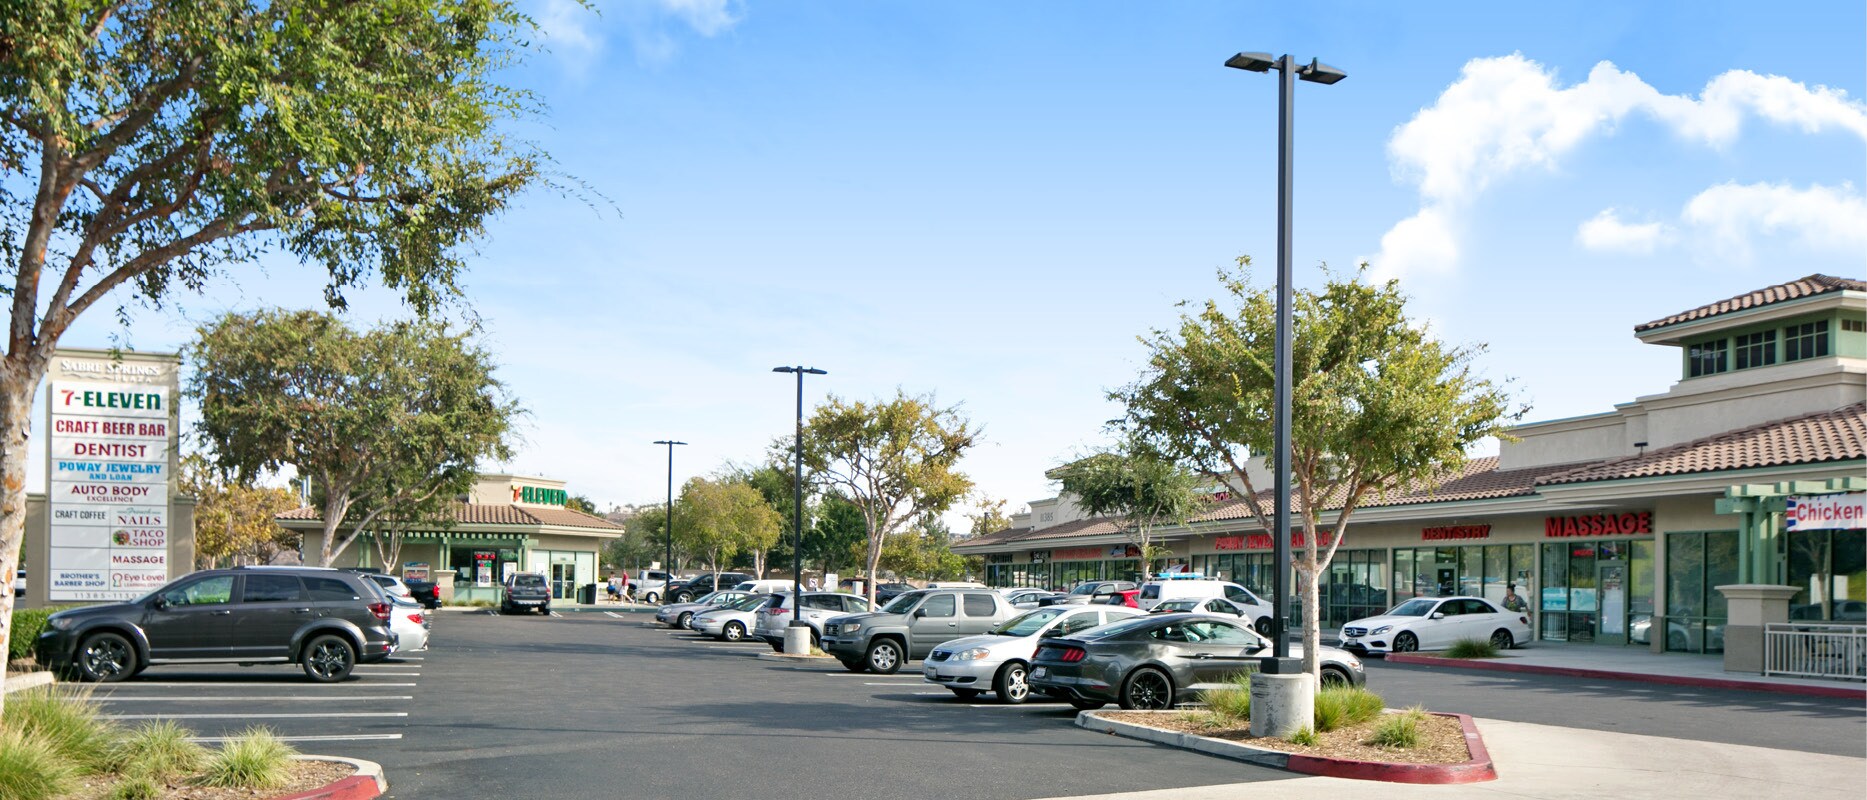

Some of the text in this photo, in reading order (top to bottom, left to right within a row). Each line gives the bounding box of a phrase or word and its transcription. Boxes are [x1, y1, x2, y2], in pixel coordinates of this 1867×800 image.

[56, 420, 165, 437] CRAFT BEER BAR
[74, 443, 147, 458] DENTIST
[59, 462, 162, 475] POWAY JEWELRY
[89, 473, 107, 481] AND
[71, 485, 149, 497] AUTO BODY
[55, 510, 106, 520] CRAFT COFFEE
[1796, 502, 1863, 521] Chicken
[118, 515, 161, 525] NAILS
[1545, 512, 1652, 537] MASSAGE
[133, 530, 164, 538] TACO
[1422, 525, 1491, 540] DENTISTRY
[112, 555, 164, 564] MASSAGE
[124, 573, 140, 582] Eye
